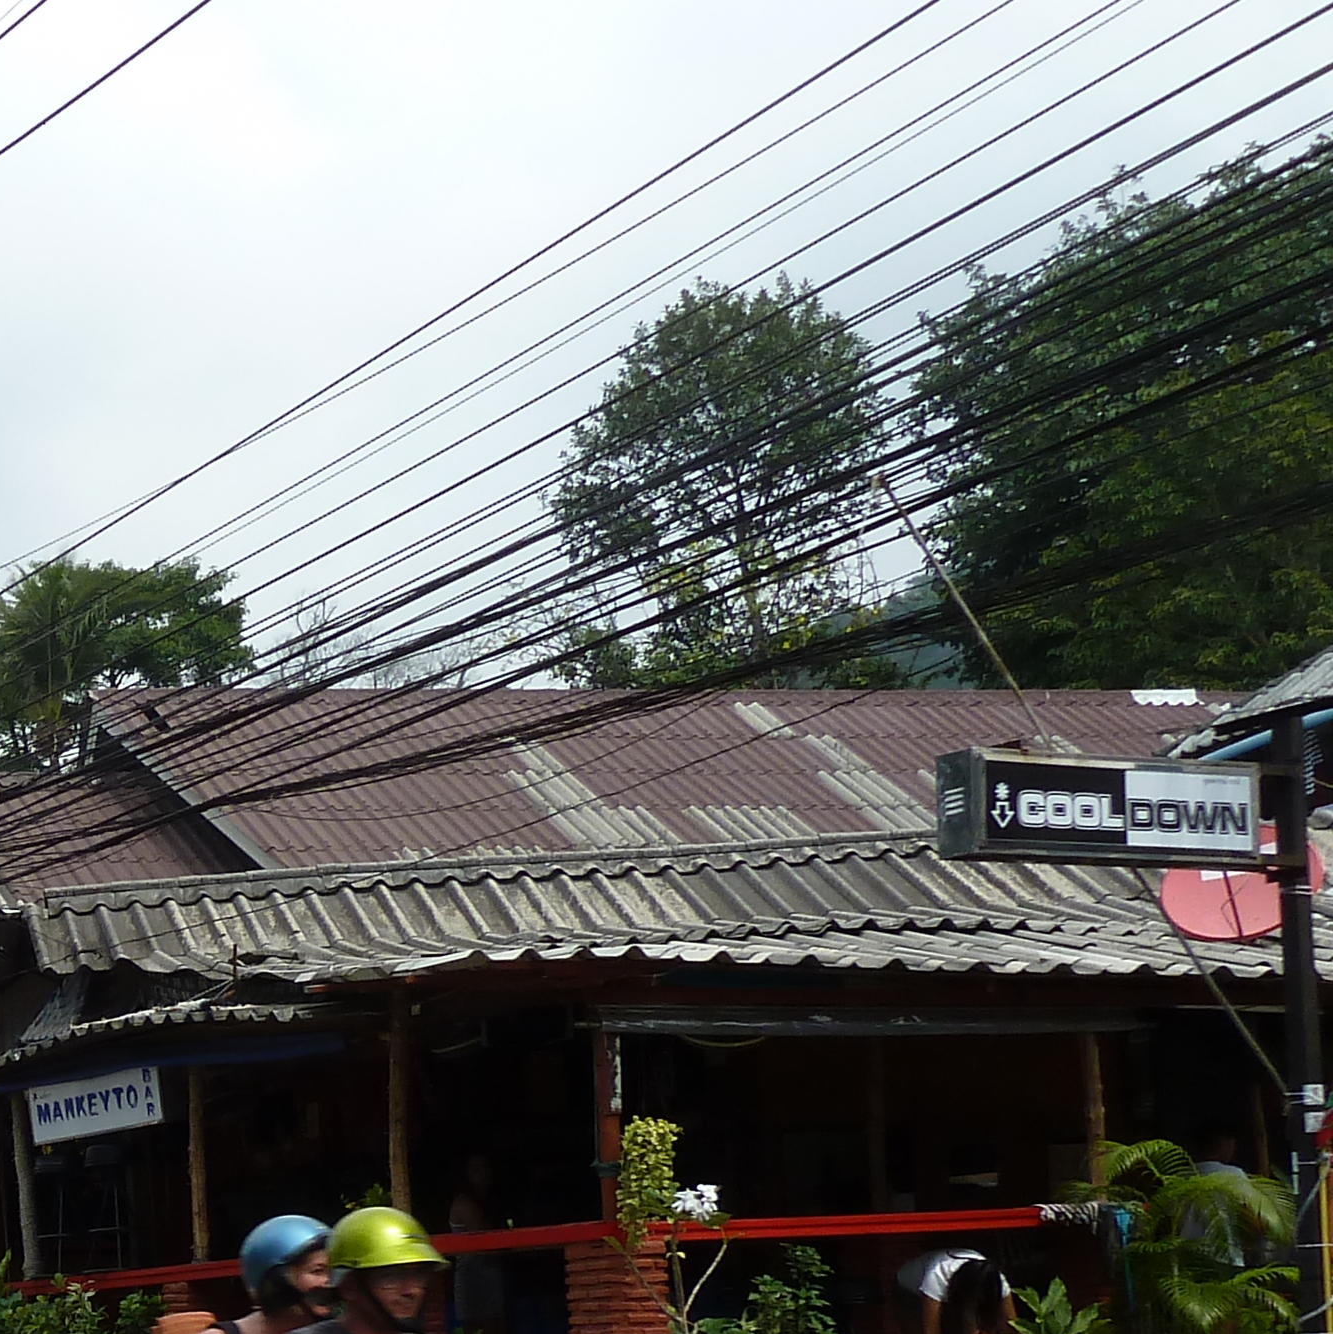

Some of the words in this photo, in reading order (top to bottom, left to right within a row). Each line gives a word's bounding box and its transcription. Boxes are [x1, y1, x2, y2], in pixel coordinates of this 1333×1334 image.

[1016, 788, 1125, 832] COOL
[1128, 798, 1249, 836] DOWN
[36, 1084, 139, 1127] MANKEYTO
[141, 1067, 156, 1117] BAR
